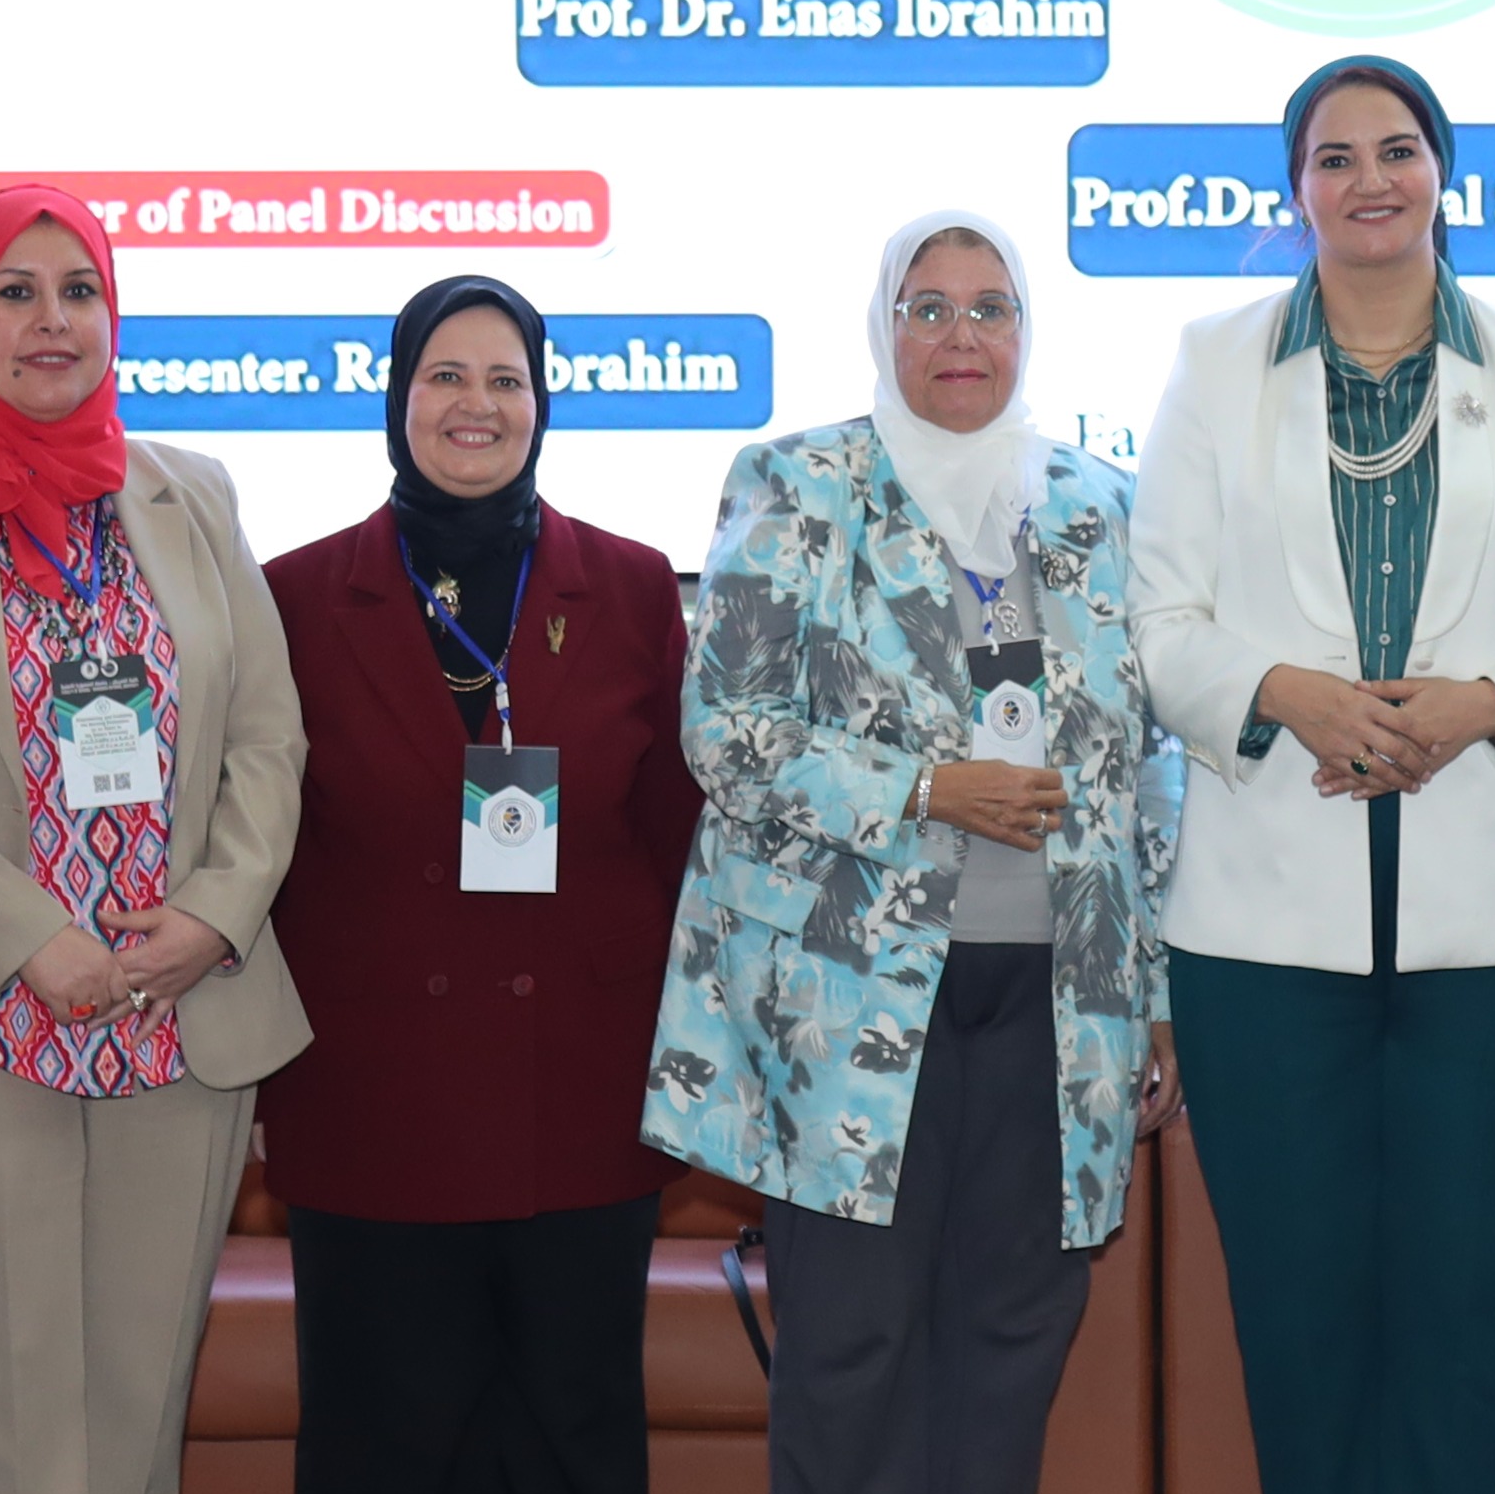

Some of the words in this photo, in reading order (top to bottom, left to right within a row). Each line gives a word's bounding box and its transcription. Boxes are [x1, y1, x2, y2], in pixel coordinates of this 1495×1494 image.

[135, 186, 191, 234] of
[198, 187, 328, 234] Panel
[339, 188, 595, 234] Discussion
[1072, 174, 1294, 228] Prof.Dr.
[112, 353, 320, 394] resenter.
[543, 339, 738, 393] brahim
